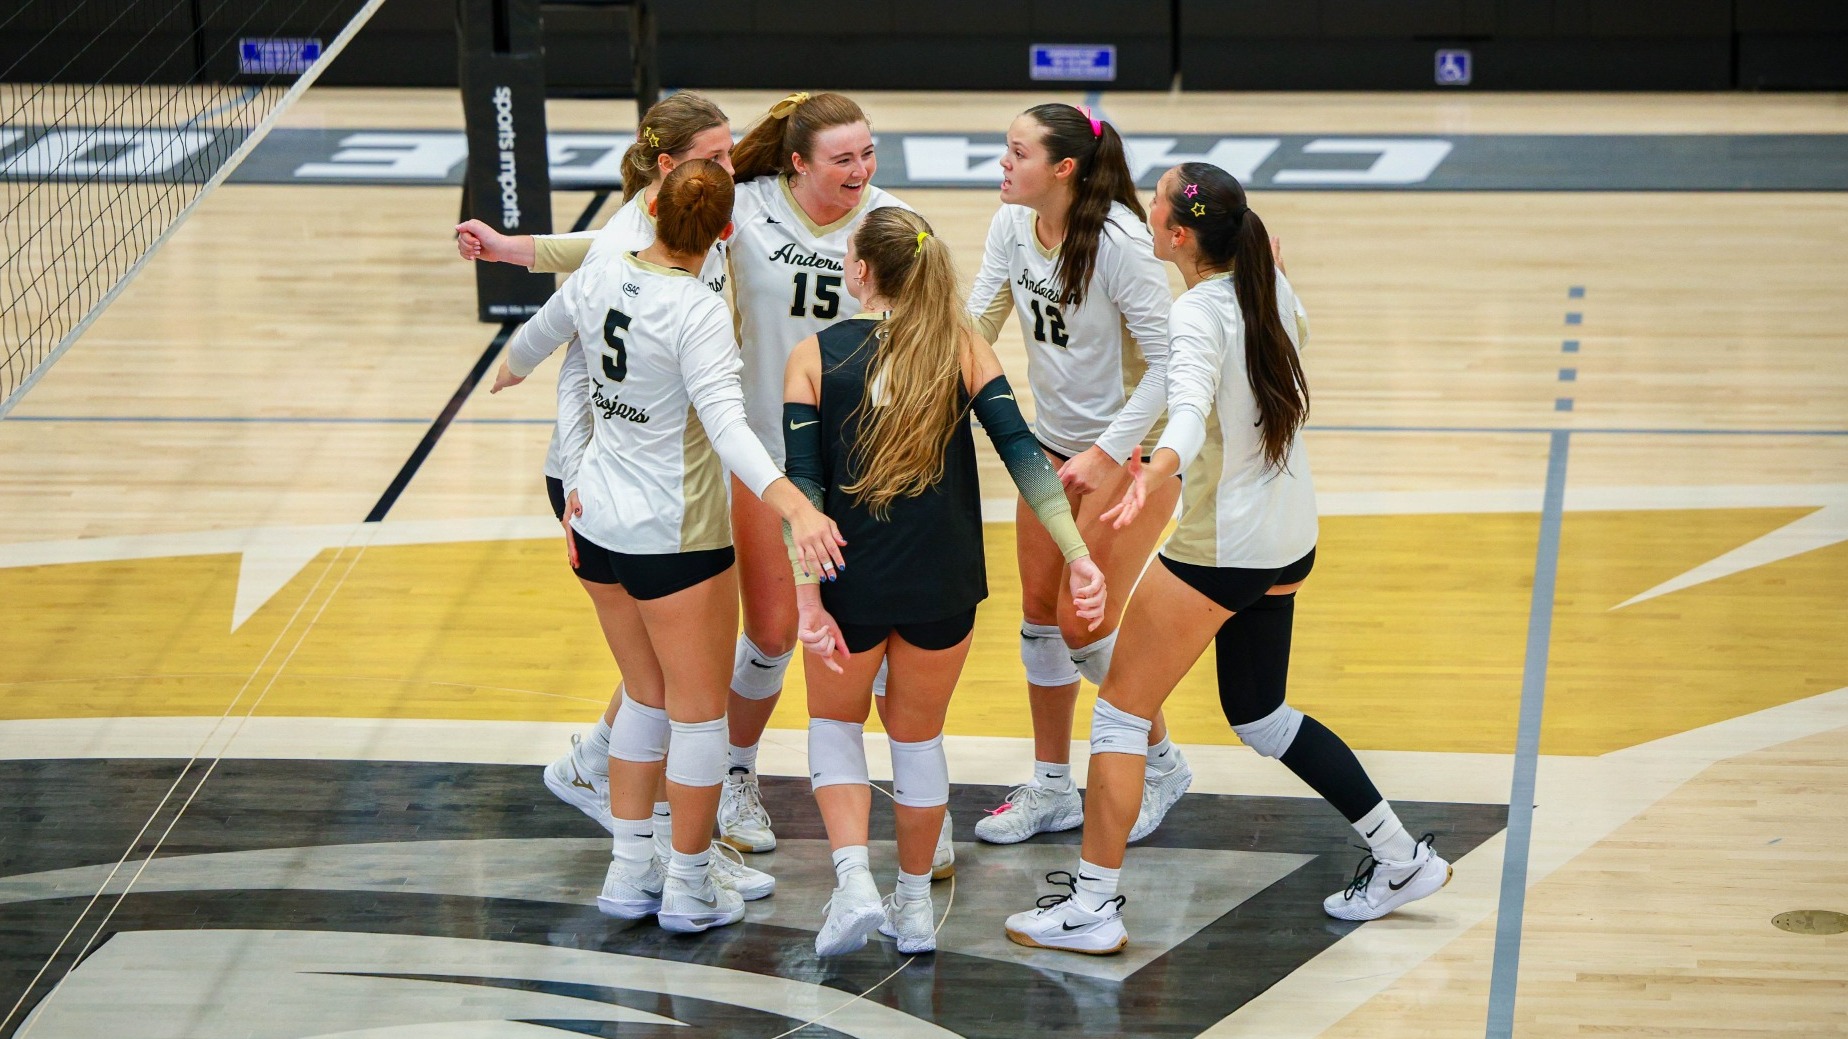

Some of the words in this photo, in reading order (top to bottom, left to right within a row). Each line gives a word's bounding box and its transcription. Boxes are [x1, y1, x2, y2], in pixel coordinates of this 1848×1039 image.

[492, 86, 517, 150] sports
[294, 133, 1453, 187] CHAGE
[497, 151, 521, 229] imports
[769, 243, 844, 271] Anders
[790, 272, 842, 320] 15
[1018, 268, 1077, 305] Andersn
[602, 308, 632, 382] 5
[1031, 299, 1069, 348] 12
[591, 378, 650, 423] Trojans
